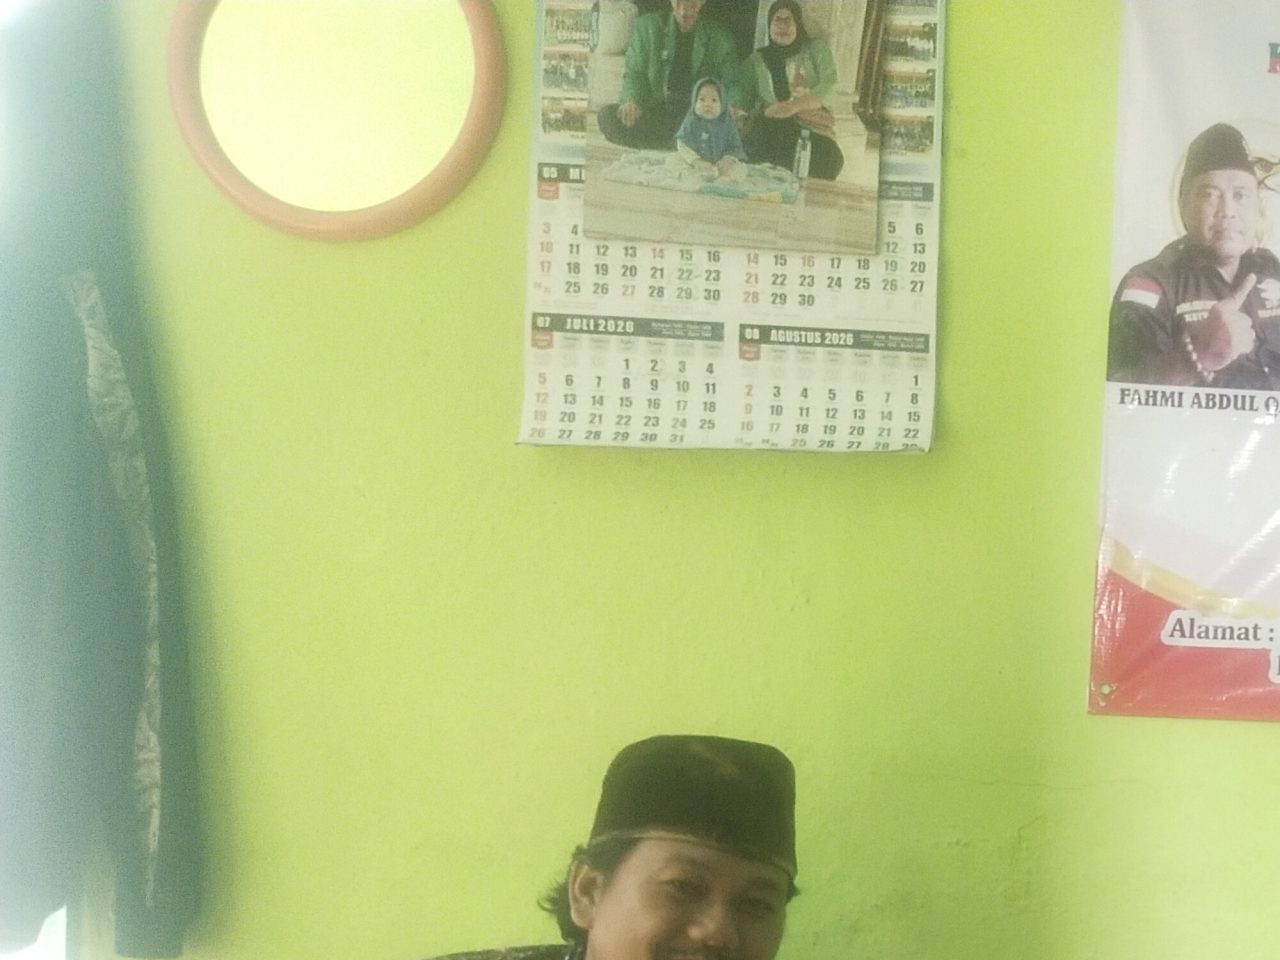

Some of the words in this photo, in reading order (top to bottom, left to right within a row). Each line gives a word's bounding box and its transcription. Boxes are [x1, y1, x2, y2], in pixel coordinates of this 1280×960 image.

[566, 319, 594, 330] JULI
[770, 328, 822, 344] AGUSTUS
[1119, 387, 1184, 409] FAHMI
[1190, 392, 1259, 412] ABDUL
[1169, 617, 1262, 642] Alamat
